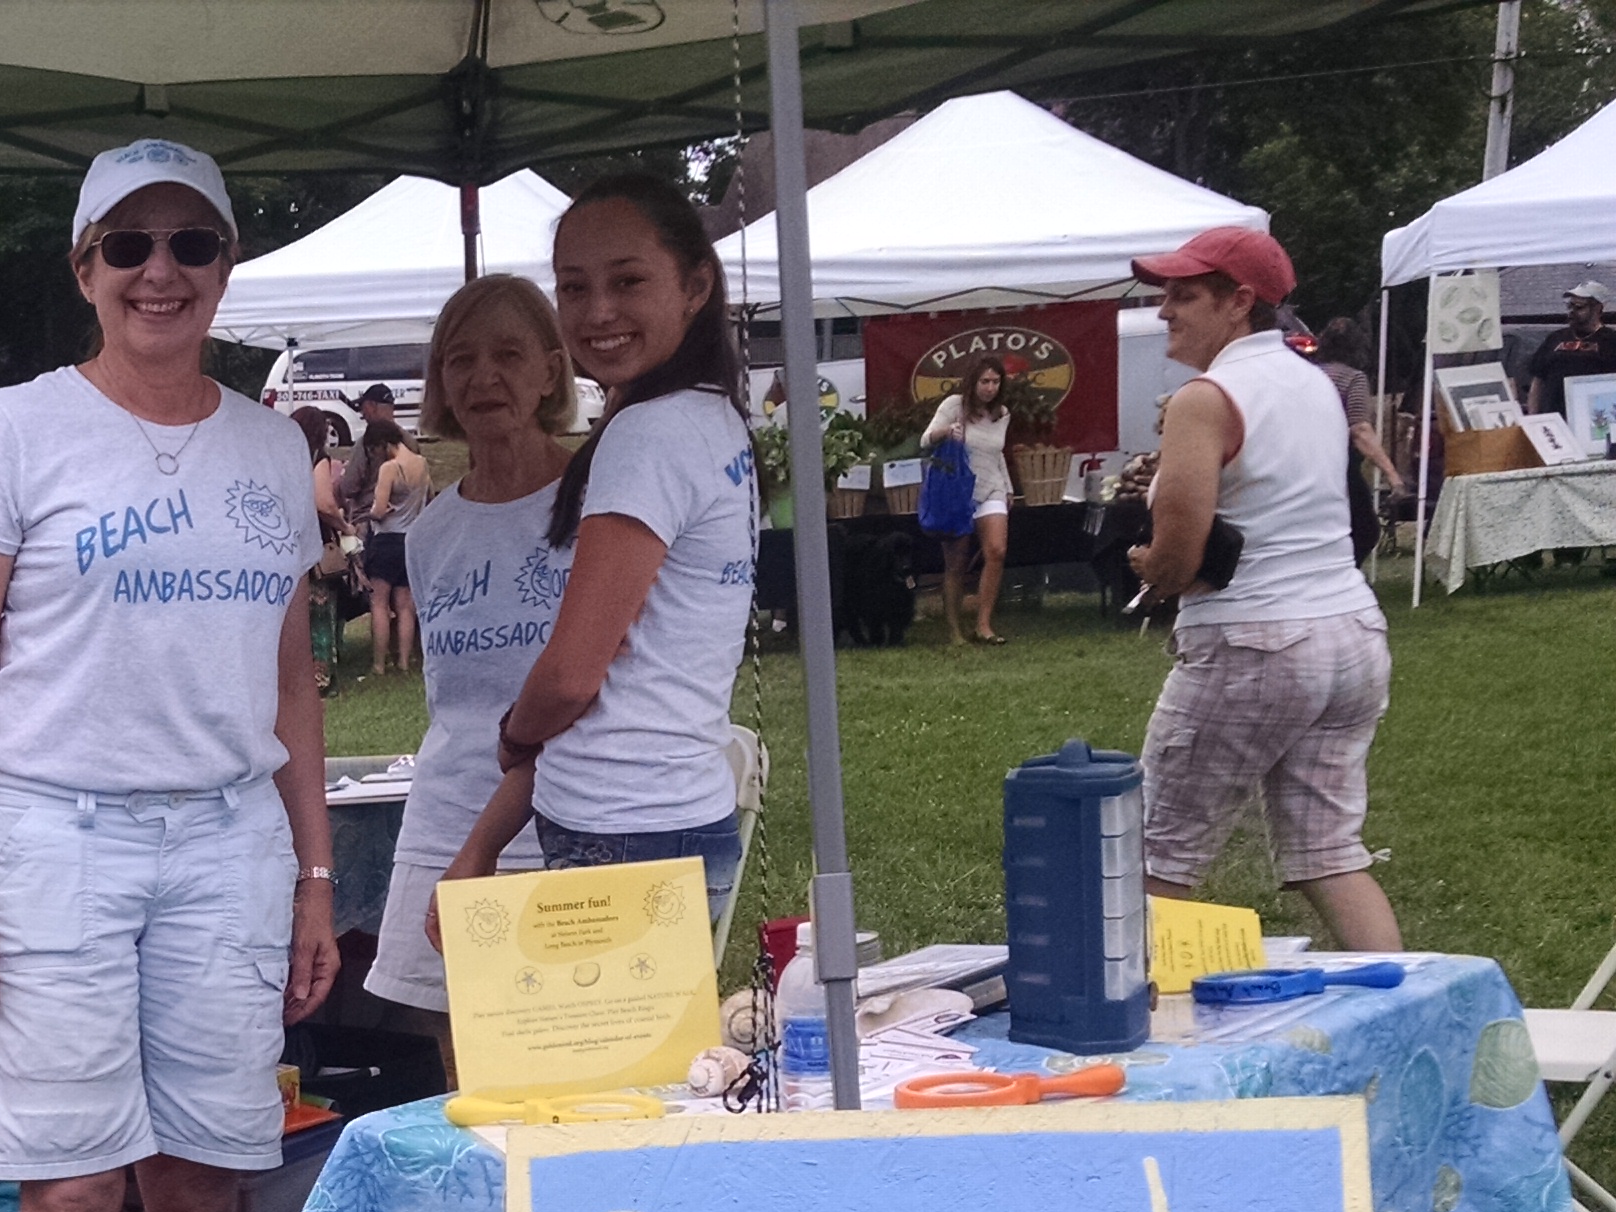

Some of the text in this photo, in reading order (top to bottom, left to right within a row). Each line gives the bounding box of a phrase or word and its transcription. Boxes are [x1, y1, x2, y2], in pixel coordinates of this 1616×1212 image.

[932, 333, 1054, 369] PLATO'S
[276, 390, 341, 401] 50-746-TAXI
[76, 489, 194, 576] BEACH
[114, 568, 294, 606] AMBASSADOR
[536, 895, 612, 914] Summer fun!
